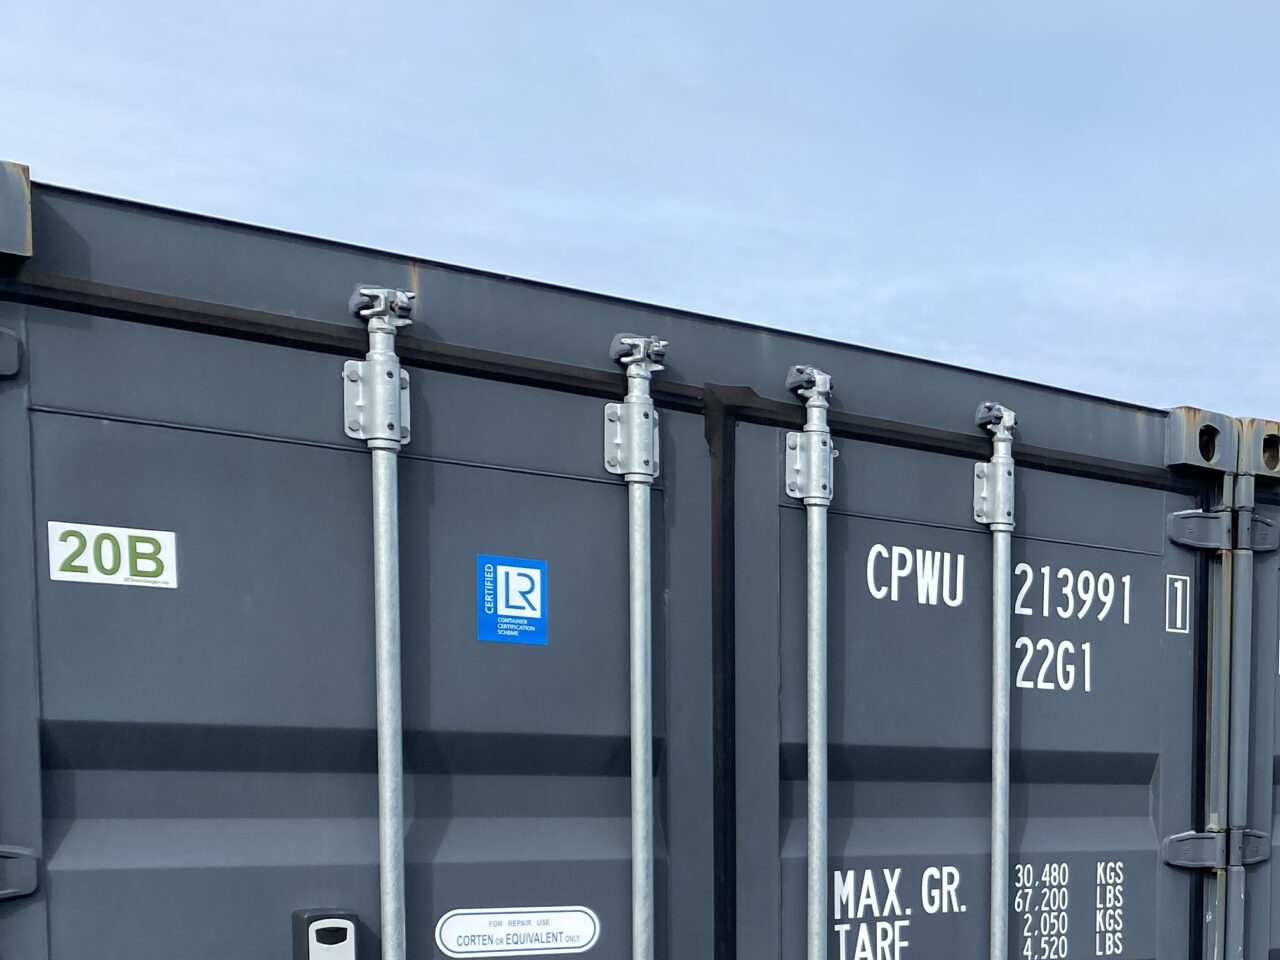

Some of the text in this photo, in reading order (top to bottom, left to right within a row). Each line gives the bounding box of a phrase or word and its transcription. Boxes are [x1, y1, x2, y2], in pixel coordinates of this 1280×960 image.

[58, 530, 164, 578] 20B
[484, 564, 494, 614] CERTIFIED
[504, 571, 537, 611] LR
[866, 543, 965, 608] CPWU
[1013, 562, 1131, 624] 213991
[497, 617, 527, 625] CONTAINER
[1014, 637, 1092, 692] 22G1
[1096, 861, 1124, 885] KGS
[833, 866, 967, 920] MAX. GR.
[1096, 885, 1123, 908] LBS
[488, 918, 550, 928] FOR REPAIR USE
[1095, 908, 1123, 932] KGS
[456, 931, 581, 947] CORTEN OR EQUIVALENT ONLY
[1095, 932, 1123, 956] LBS
